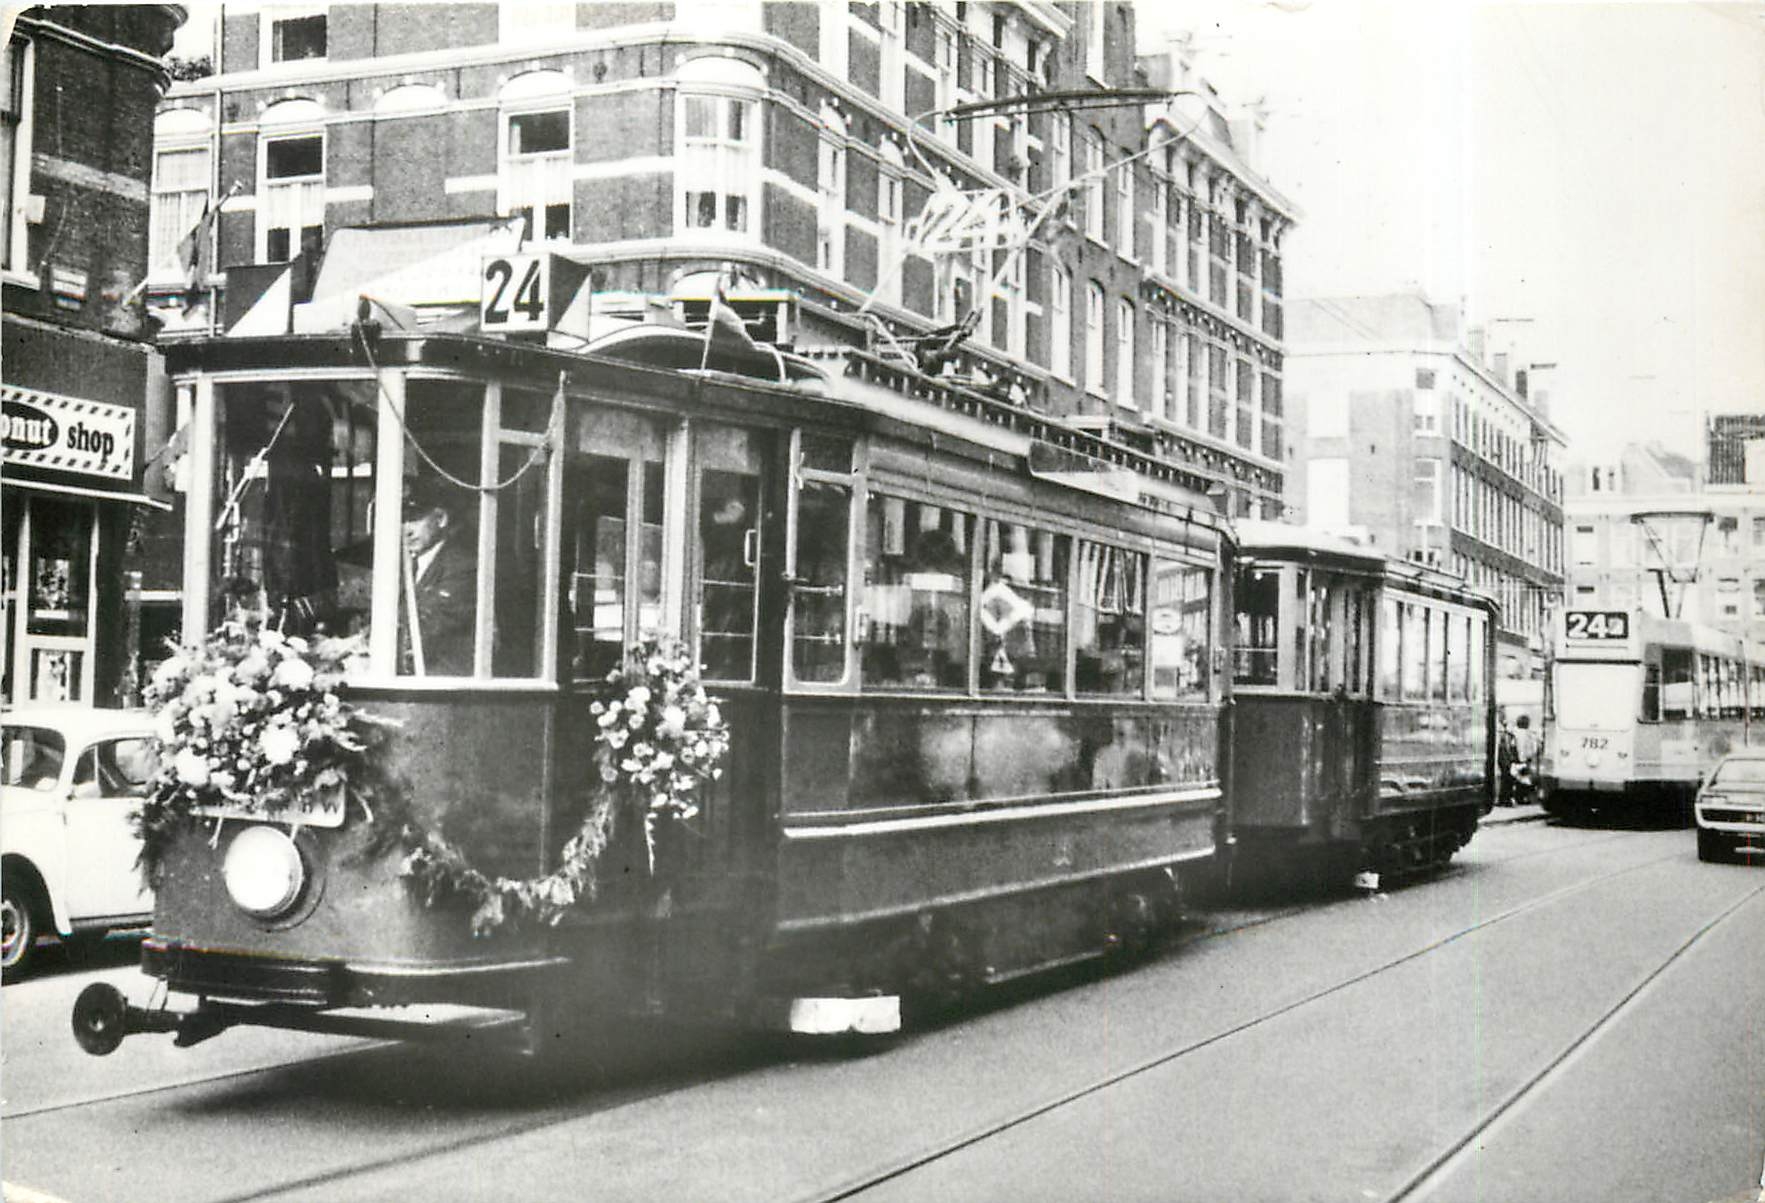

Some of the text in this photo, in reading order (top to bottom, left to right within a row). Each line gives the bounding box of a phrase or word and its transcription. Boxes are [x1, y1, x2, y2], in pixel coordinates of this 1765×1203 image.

[485, 259, 544, 324] 24
[67, 422, 114, 464] shop
[1581, 737, 1609, 750] 782
